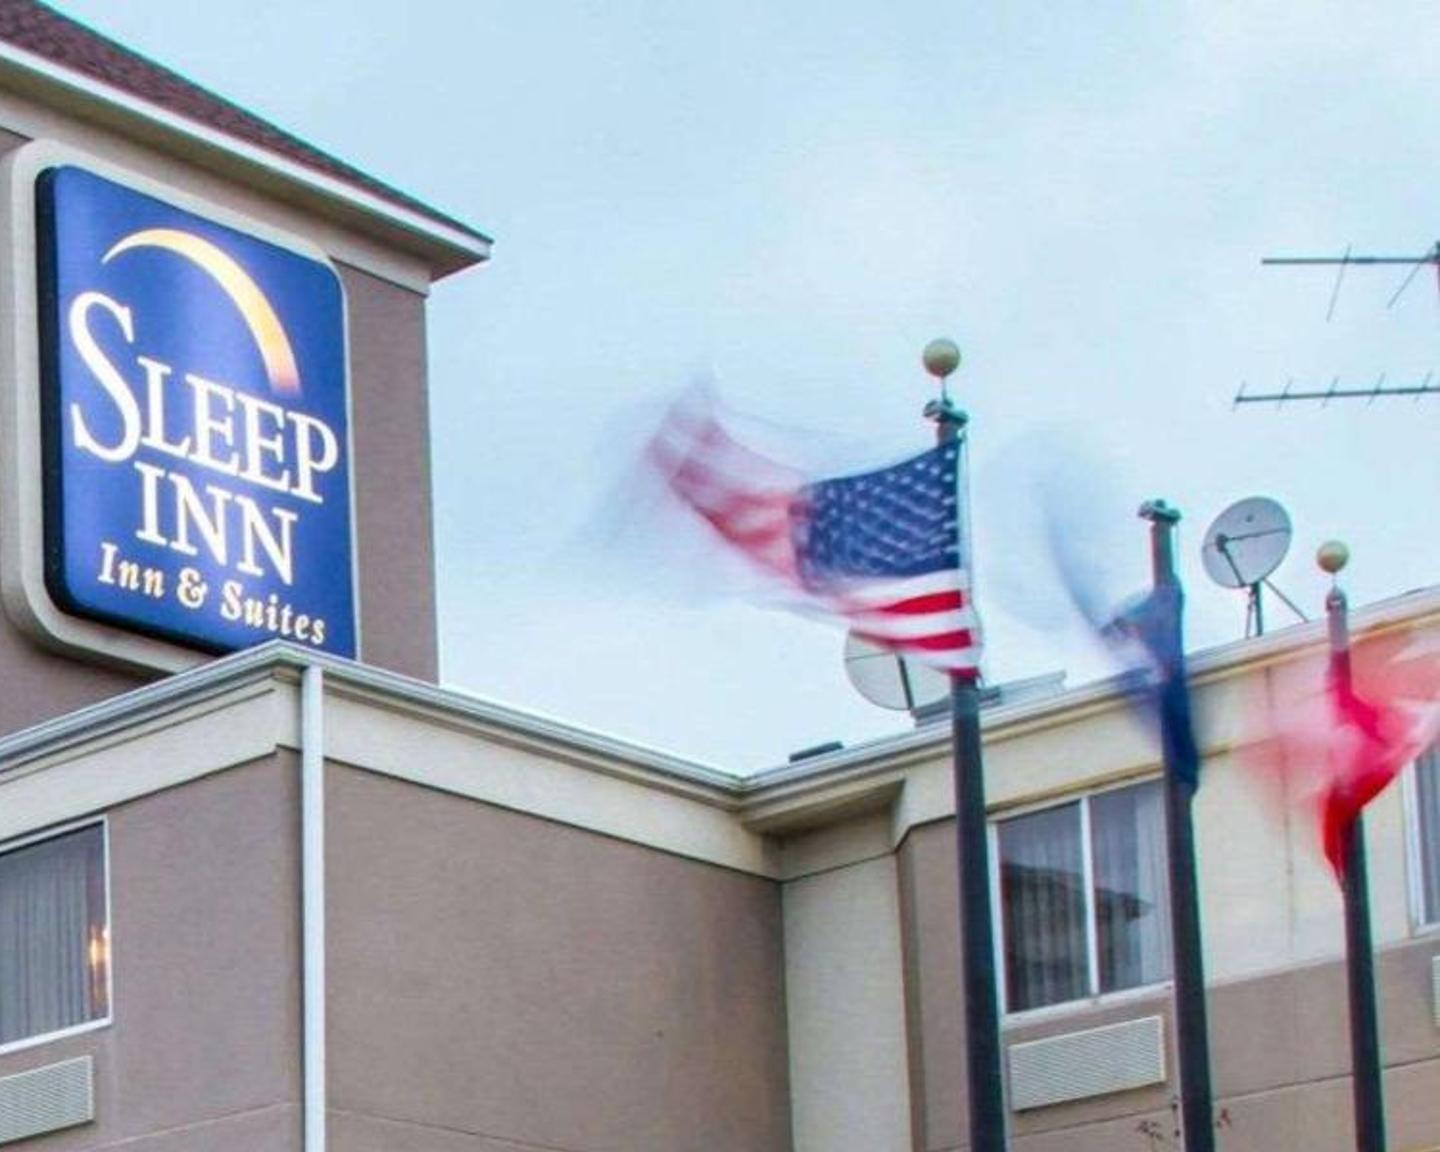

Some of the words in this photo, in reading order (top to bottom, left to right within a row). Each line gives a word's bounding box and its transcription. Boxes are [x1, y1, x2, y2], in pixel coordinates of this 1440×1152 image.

[68, 291, 339, 504] SLEEP
[133, 460, 299, 586] INN
[97, 542, 165, 598] Inn
[176, 566, 208, 609] &
[220, 579, 327, 645] Suites
